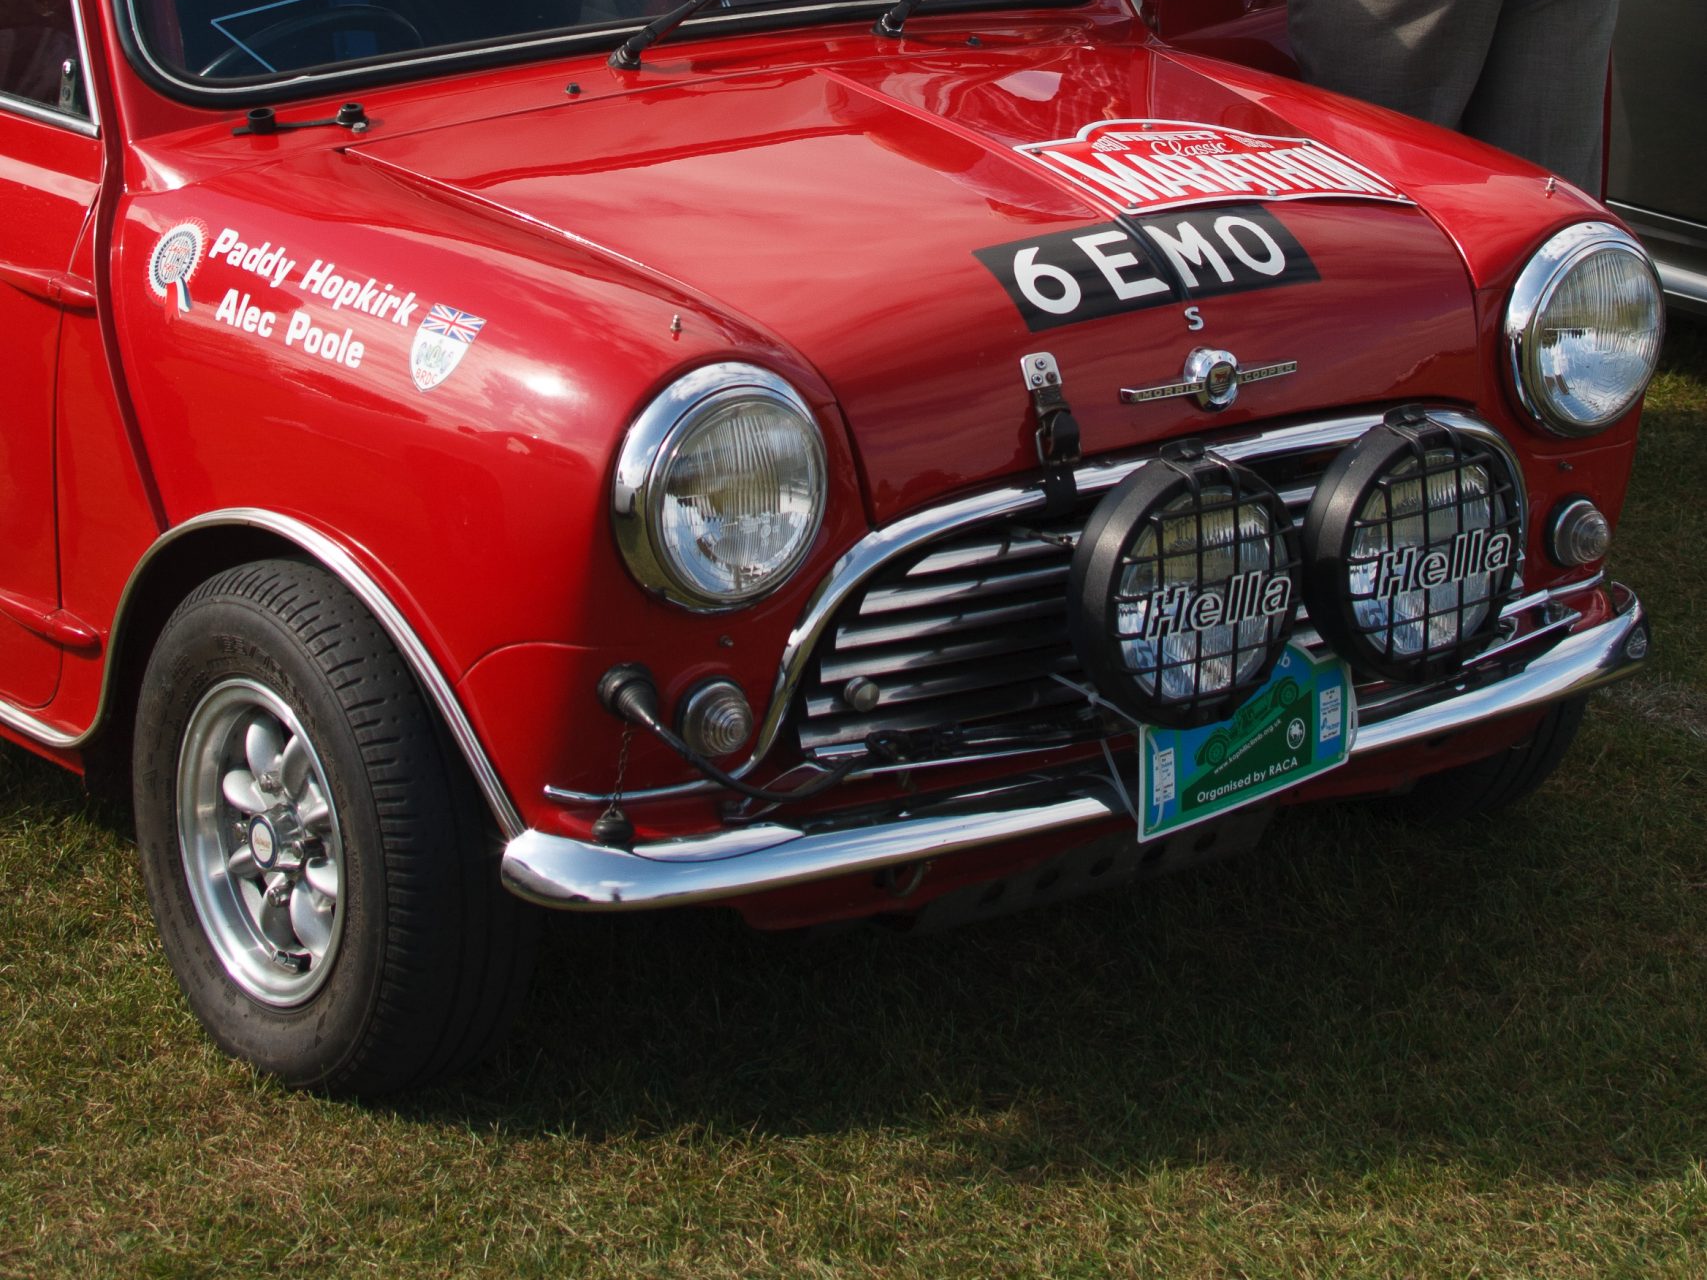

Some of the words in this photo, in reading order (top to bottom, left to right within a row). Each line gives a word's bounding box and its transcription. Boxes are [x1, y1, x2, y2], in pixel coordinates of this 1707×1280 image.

[1150, 140, 1234, 157] Classic
[1043, 146, 1396, 204] MARATHON
[208, 228, 296, 288] Paddy
[299, 259, 418, 327] Hopkirk
[215, 288, 276, 338] Alec
[285, 310, 365, 368] Poole
[1184, 306, 1204, 330] S
[415, 367, 438, 385] BRDC
[1142, 384, 1200, 400] MORRIS
[1244, 363, 1296, 381] COOPER
[1377, 529, 1511, 600] Hella
[1145, 571, 1292, 641] Hella
[1197, 774, 1251, 802] Organised
[1253, 771, 1266, 781] by
[1269, 756, 1298, 776] RACA
